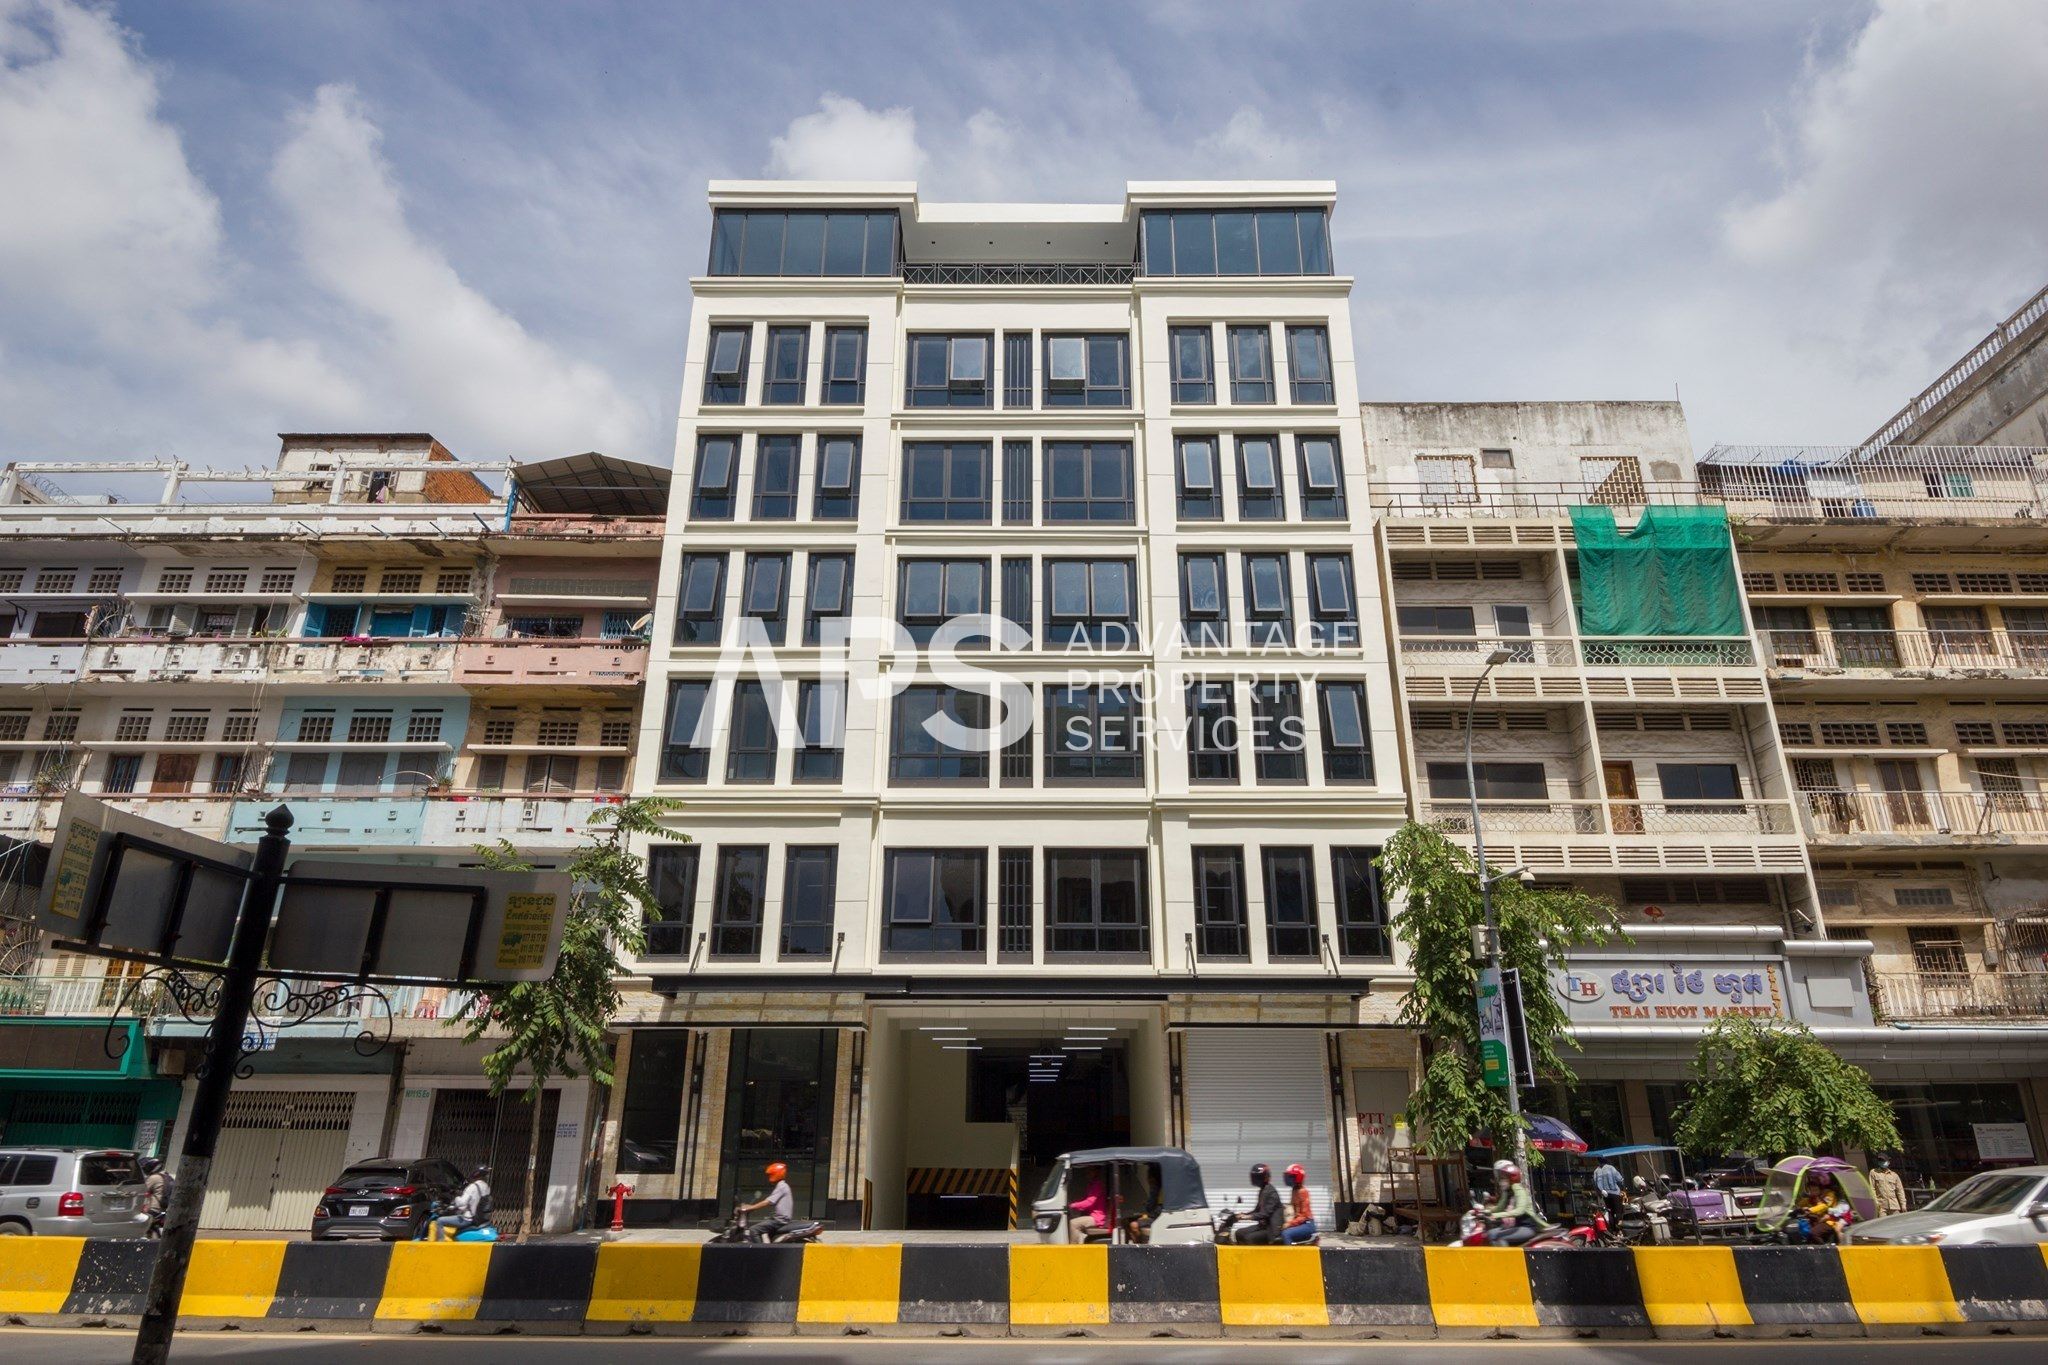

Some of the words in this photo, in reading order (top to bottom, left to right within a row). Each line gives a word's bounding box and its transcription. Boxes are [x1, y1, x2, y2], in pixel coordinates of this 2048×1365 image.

[1566, 976, 1598, 996] TH
[1611, 969, 1665, 1003] ផ្សារ
[1609, 1005, 1650, 1019] THAI
[1655, 1005, 1697, 1019] HUOT
[1703, 1005, 1772, 1019] MARKET
[1357, 1112, 1385, 1124] PTT
